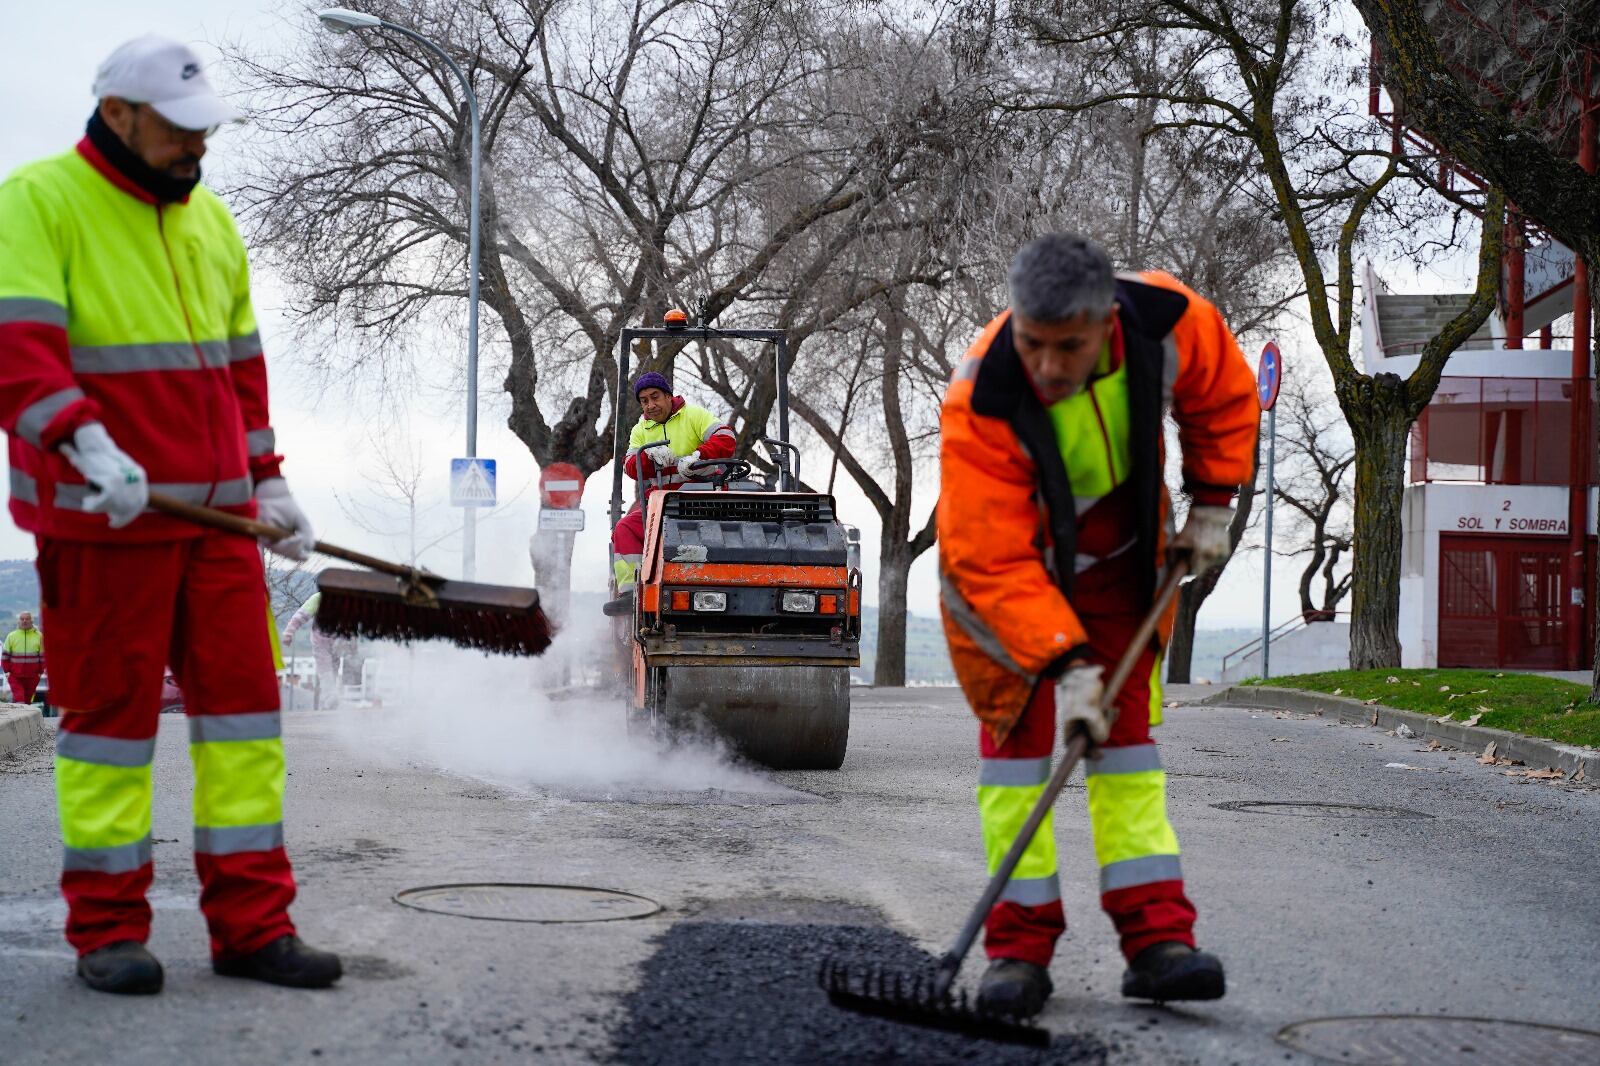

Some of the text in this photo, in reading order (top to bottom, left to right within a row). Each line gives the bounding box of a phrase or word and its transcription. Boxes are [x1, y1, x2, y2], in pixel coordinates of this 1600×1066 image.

[1502, 500, 1512, 511] 2
[1457, 517, 1567, 531] SOL Y SOMBRA
